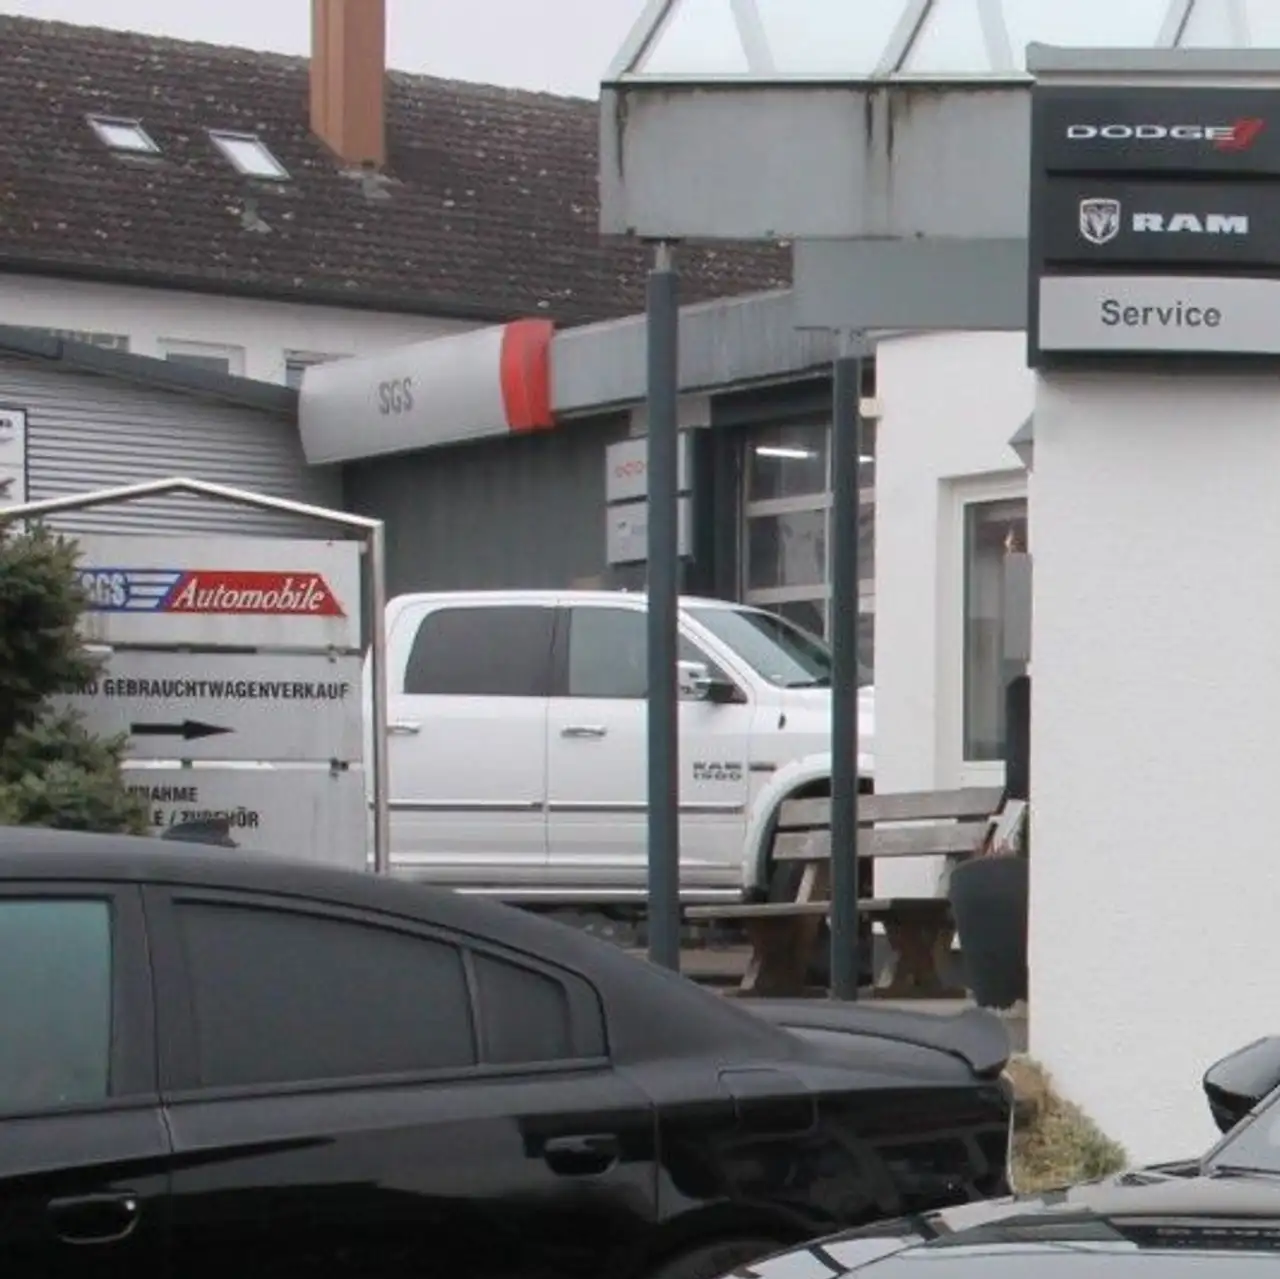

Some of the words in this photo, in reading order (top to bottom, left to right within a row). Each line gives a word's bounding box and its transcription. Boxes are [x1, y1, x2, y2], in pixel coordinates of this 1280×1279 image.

[1066, 124, 1236, 141] DODGE
[1132, 212, 1249, 234] RAM
[1100, 300, 1222, 327] Service
[379, 376, 413, 416] SGS
[173, 576, 325, 610] Automobile
[103, 679, 349, 699] GEBRAUCHTWAGENVERKAUF
